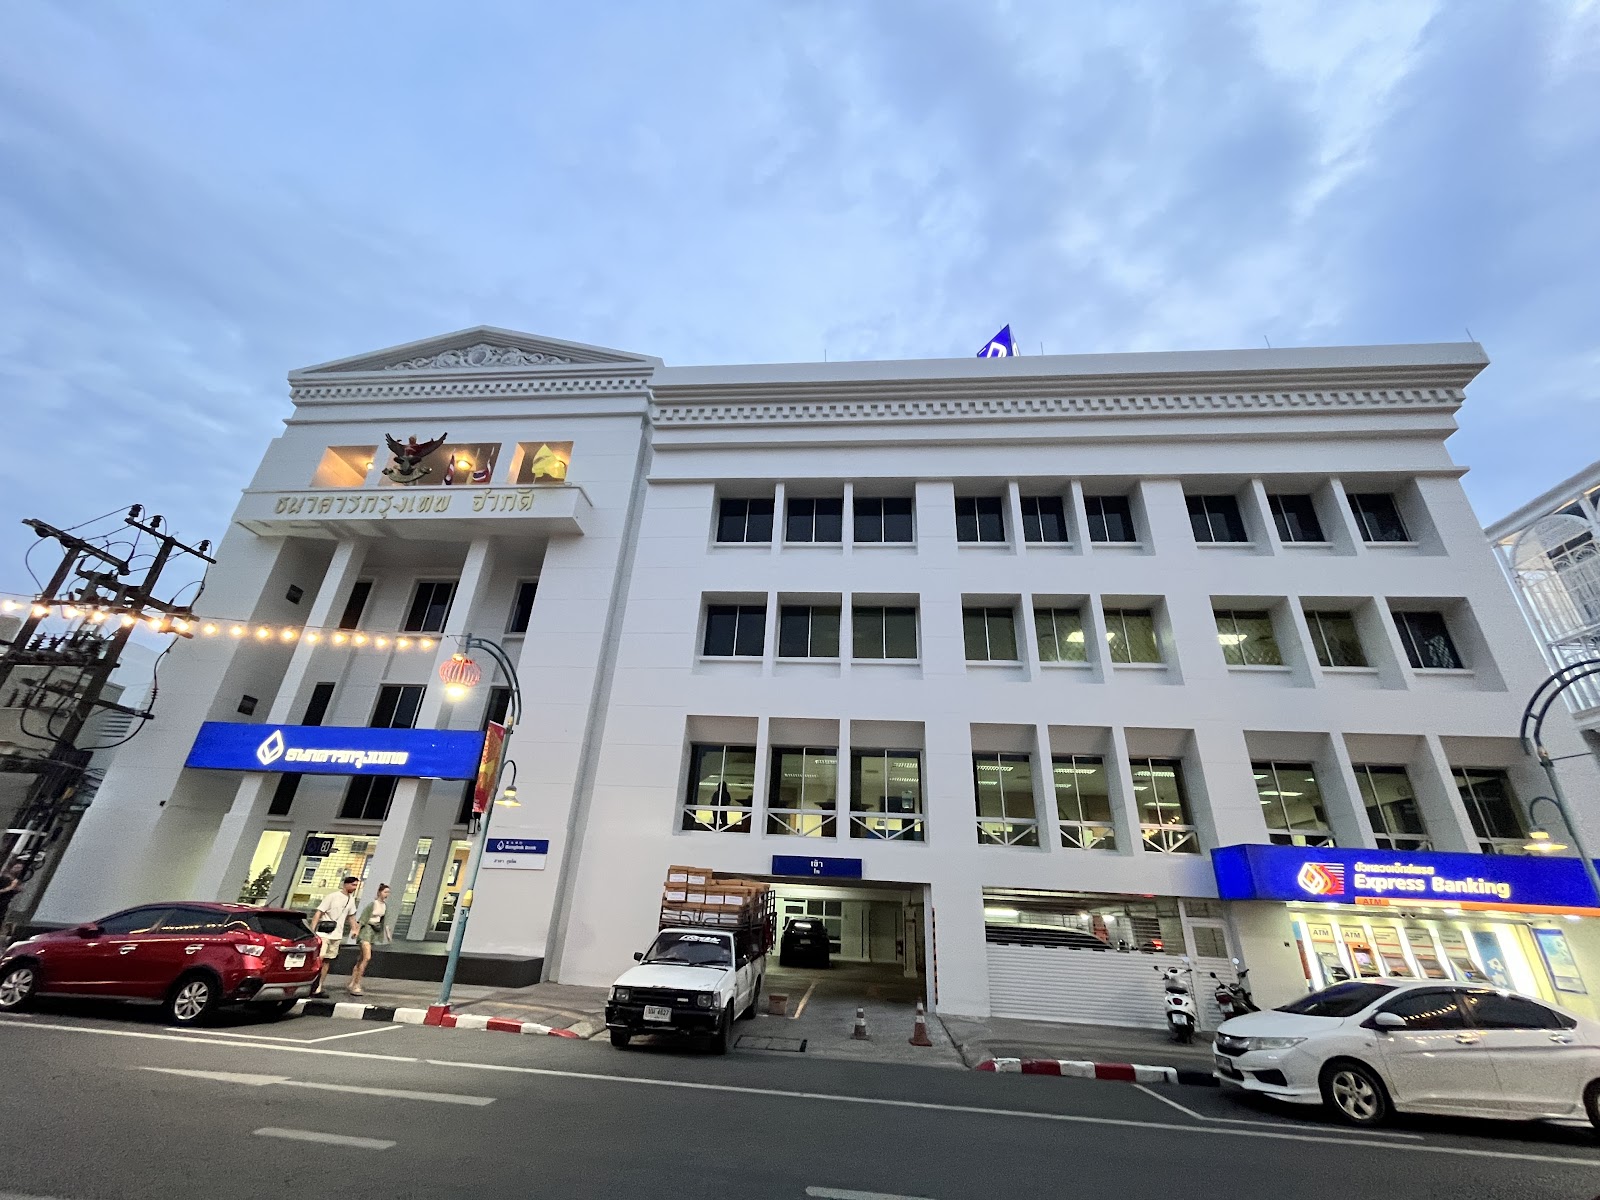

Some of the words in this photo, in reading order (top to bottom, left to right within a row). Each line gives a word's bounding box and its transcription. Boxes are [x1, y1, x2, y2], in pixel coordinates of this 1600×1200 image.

[274, 494, 452, 519] ธนาคารกรุงเทพ
[473, 488, 534, 512] จำกัด
[810, 859, 823, 868] เข้า
[1354, 874, 1426, 892] Express
[1432, 877, 1510, 898] Banking
